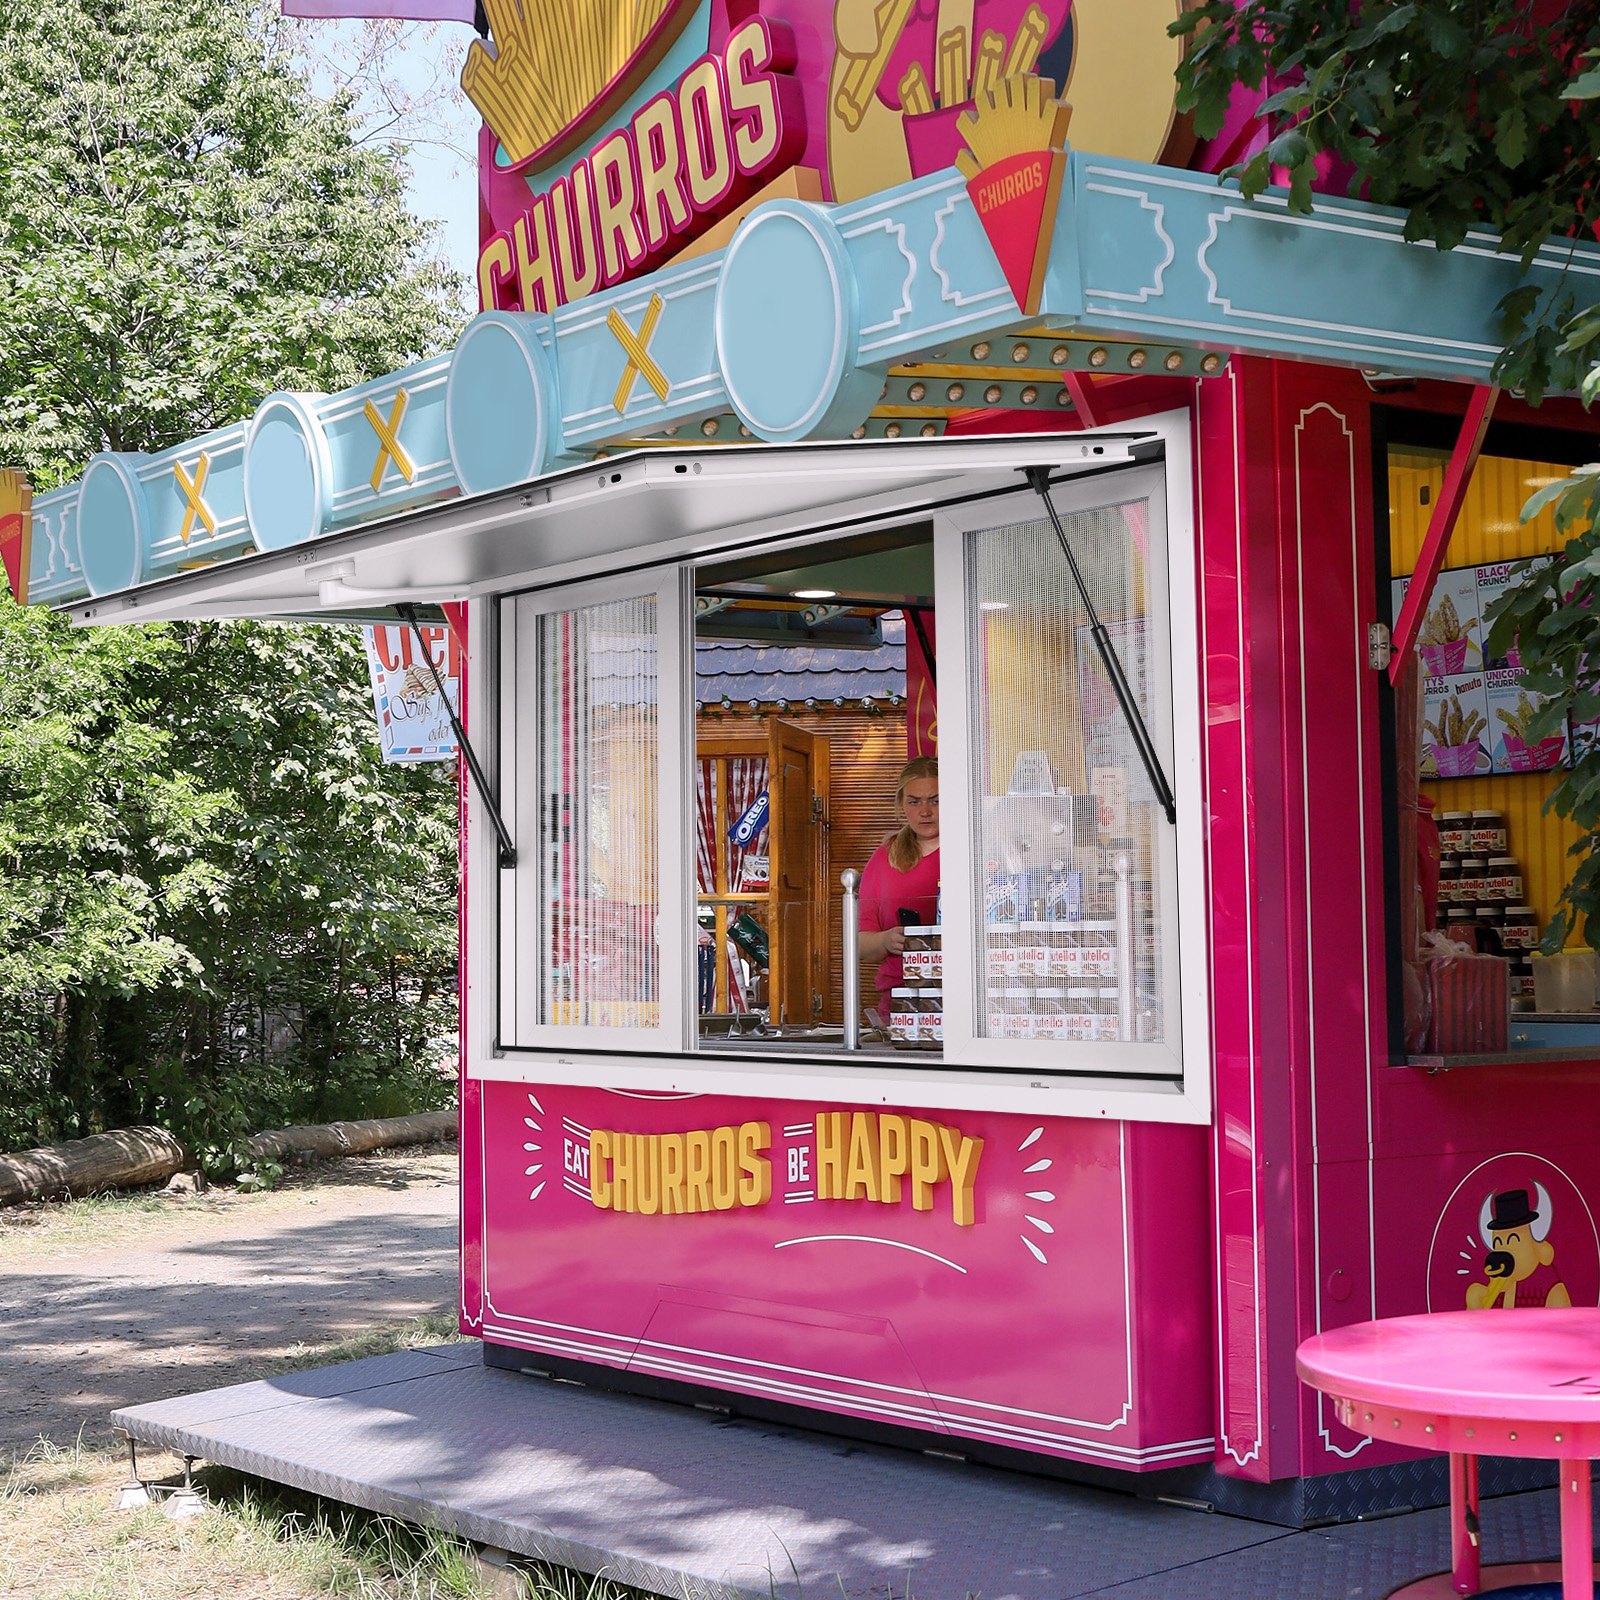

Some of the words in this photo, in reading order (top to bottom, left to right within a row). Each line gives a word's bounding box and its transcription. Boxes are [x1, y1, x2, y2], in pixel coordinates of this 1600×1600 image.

[479, 14, 790, 312] CHURROS
[978, 161, 1043, 214] CHURROS
[1477, 565, 1511, 579] BLACK
[1478, 576, 1511, 587] CRUNCH
[738, 796, 768, 842] OREO
[564, 1137, 590, 1181] EAT
[589, 1121, 773, 1216] CHURROS
[787, 1145, 810, 1183] BE
[815, 1111, 985, 1227] HAPPY
